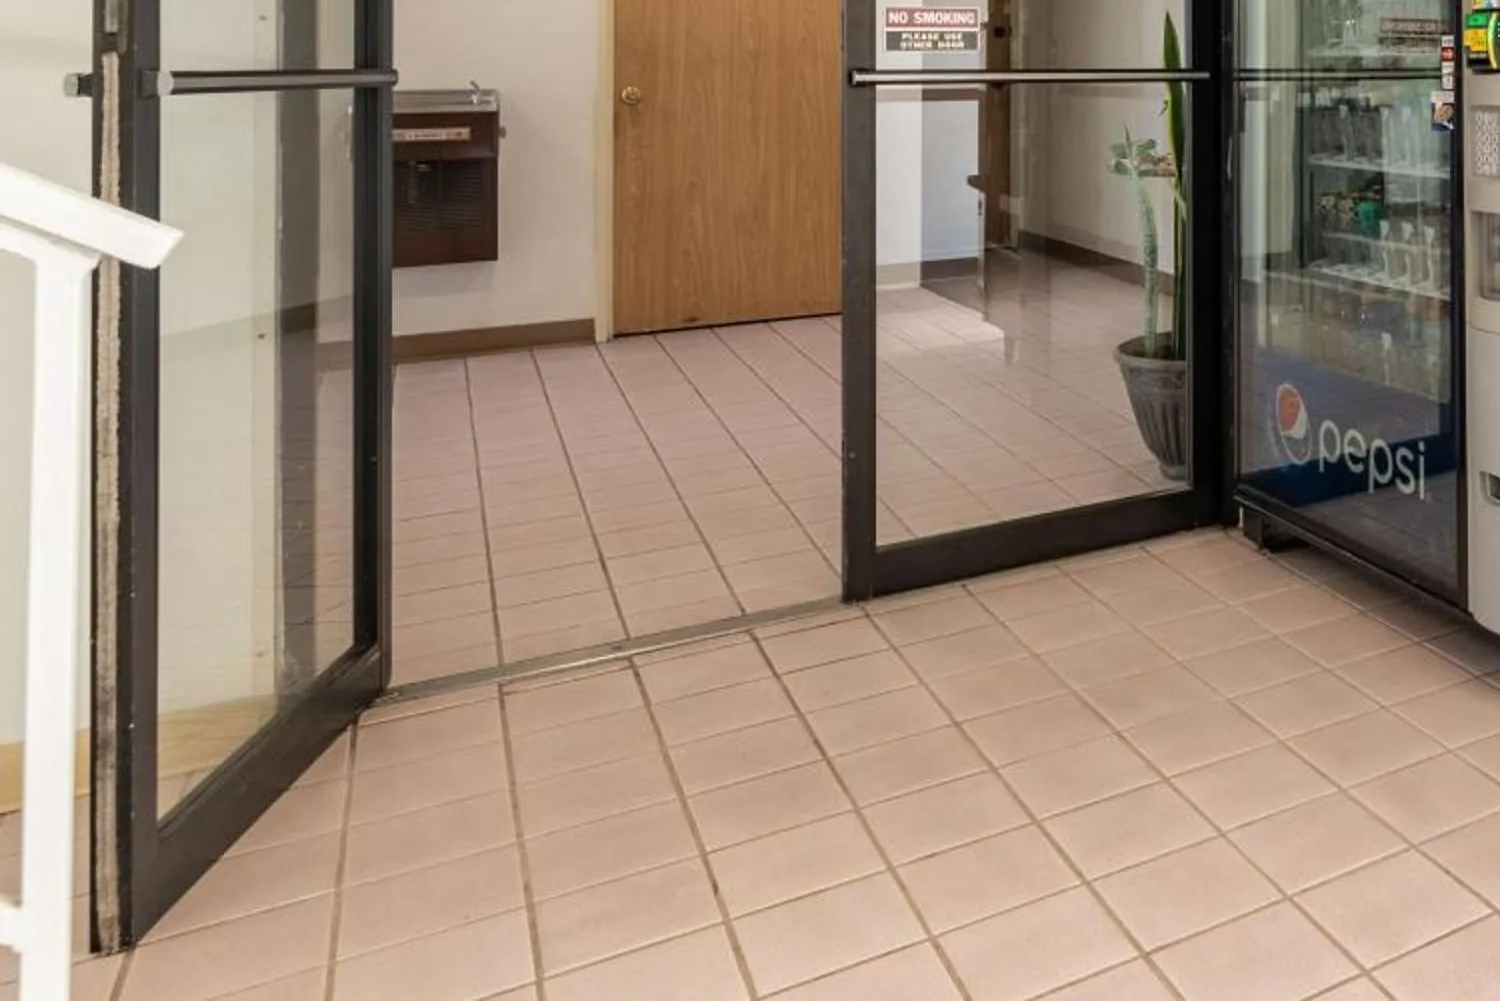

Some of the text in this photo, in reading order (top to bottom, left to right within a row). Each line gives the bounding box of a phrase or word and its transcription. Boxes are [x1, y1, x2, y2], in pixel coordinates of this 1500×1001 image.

[888, 10, 975, 24] NO SMOKING
[1319, 419, 1425, 500] pepsi
